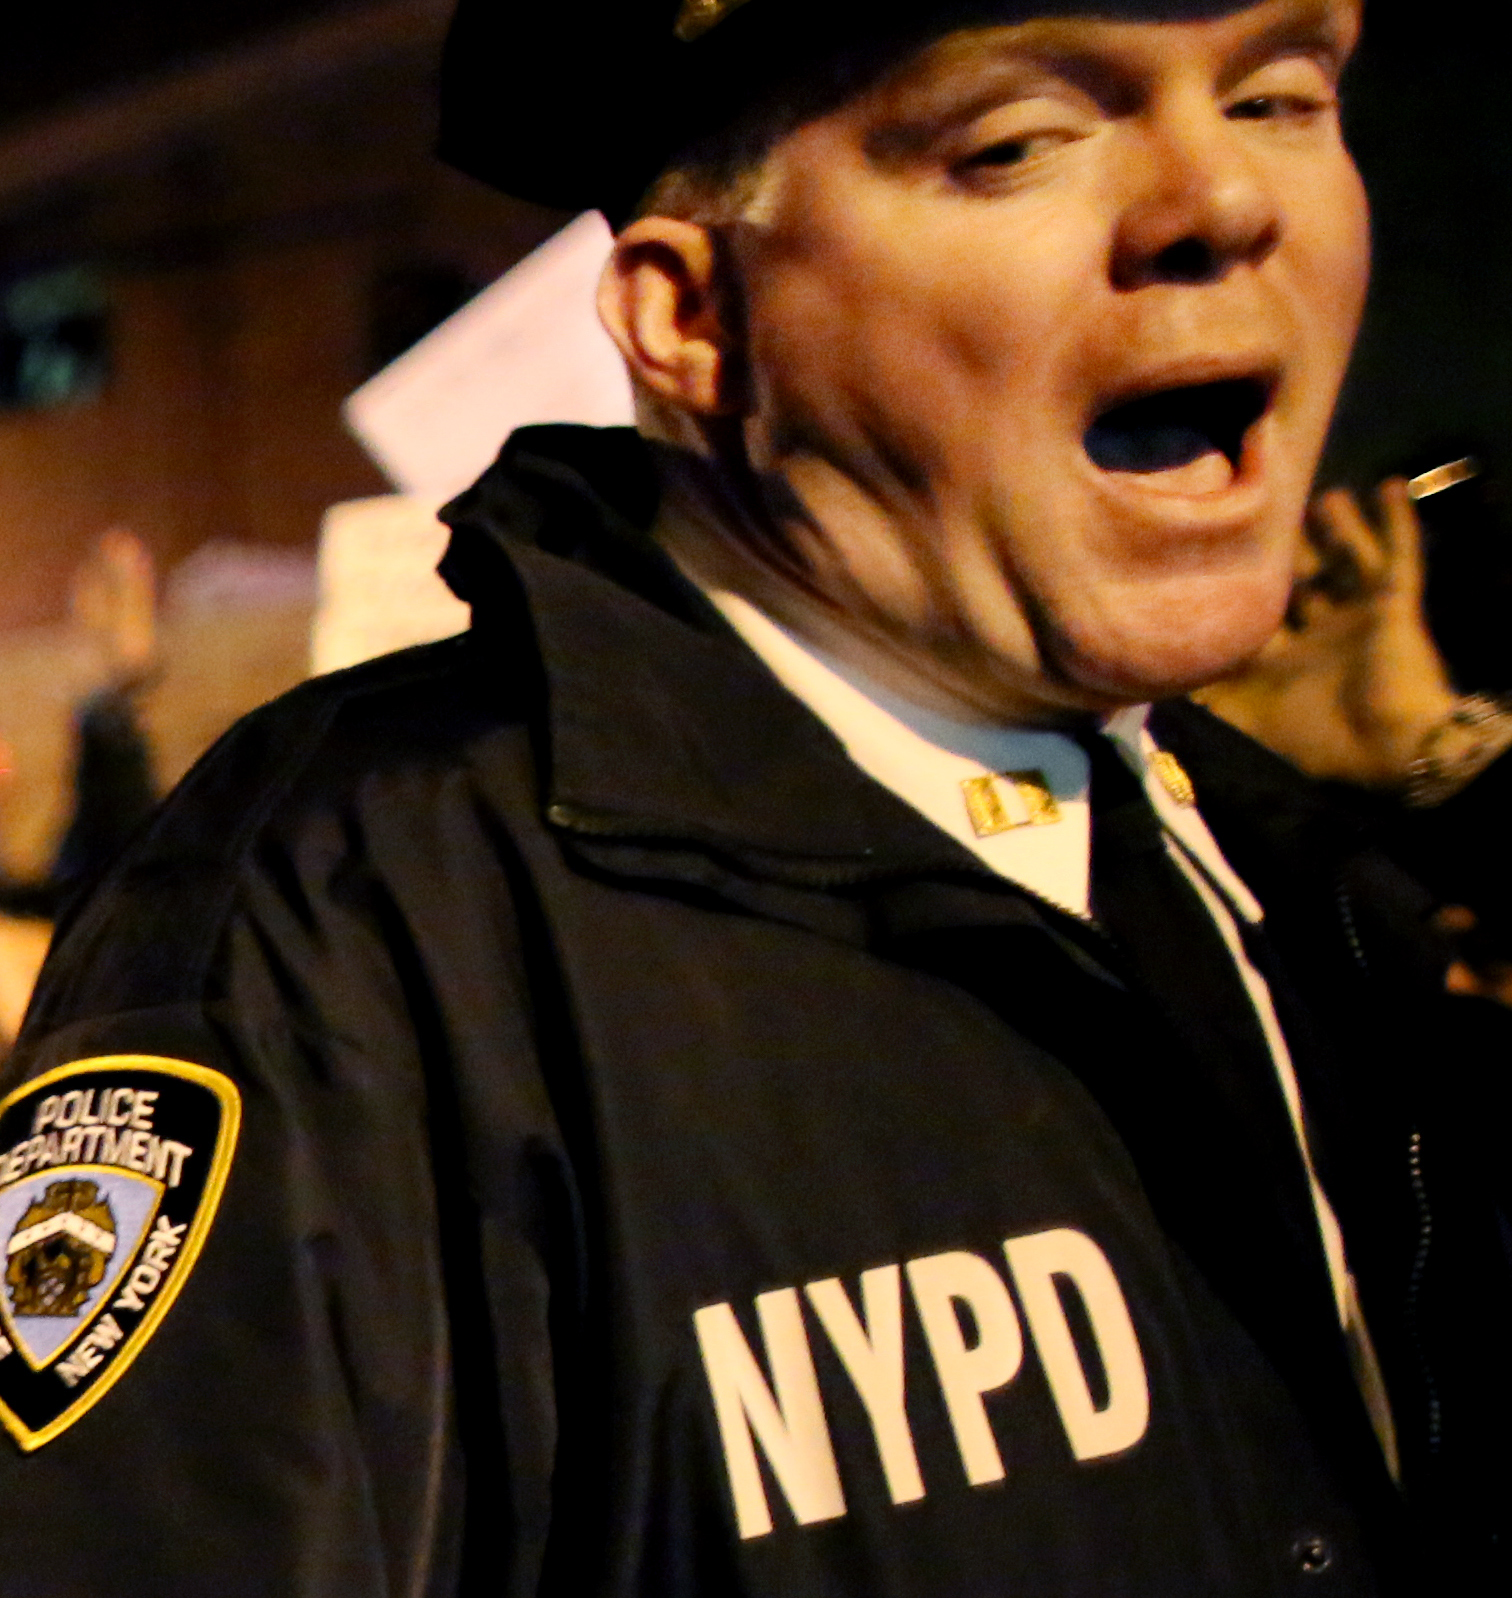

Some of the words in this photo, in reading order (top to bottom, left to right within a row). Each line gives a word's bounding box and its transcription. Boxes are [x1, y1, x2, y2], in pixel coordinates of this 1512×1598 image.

[31, 1087, 160, 1135] POLICE
[54, 1313, 125, 1389] NEW
[113, 1214, 189, 1313] YORK
[693, 1227, 1150, 1541] NYPD
